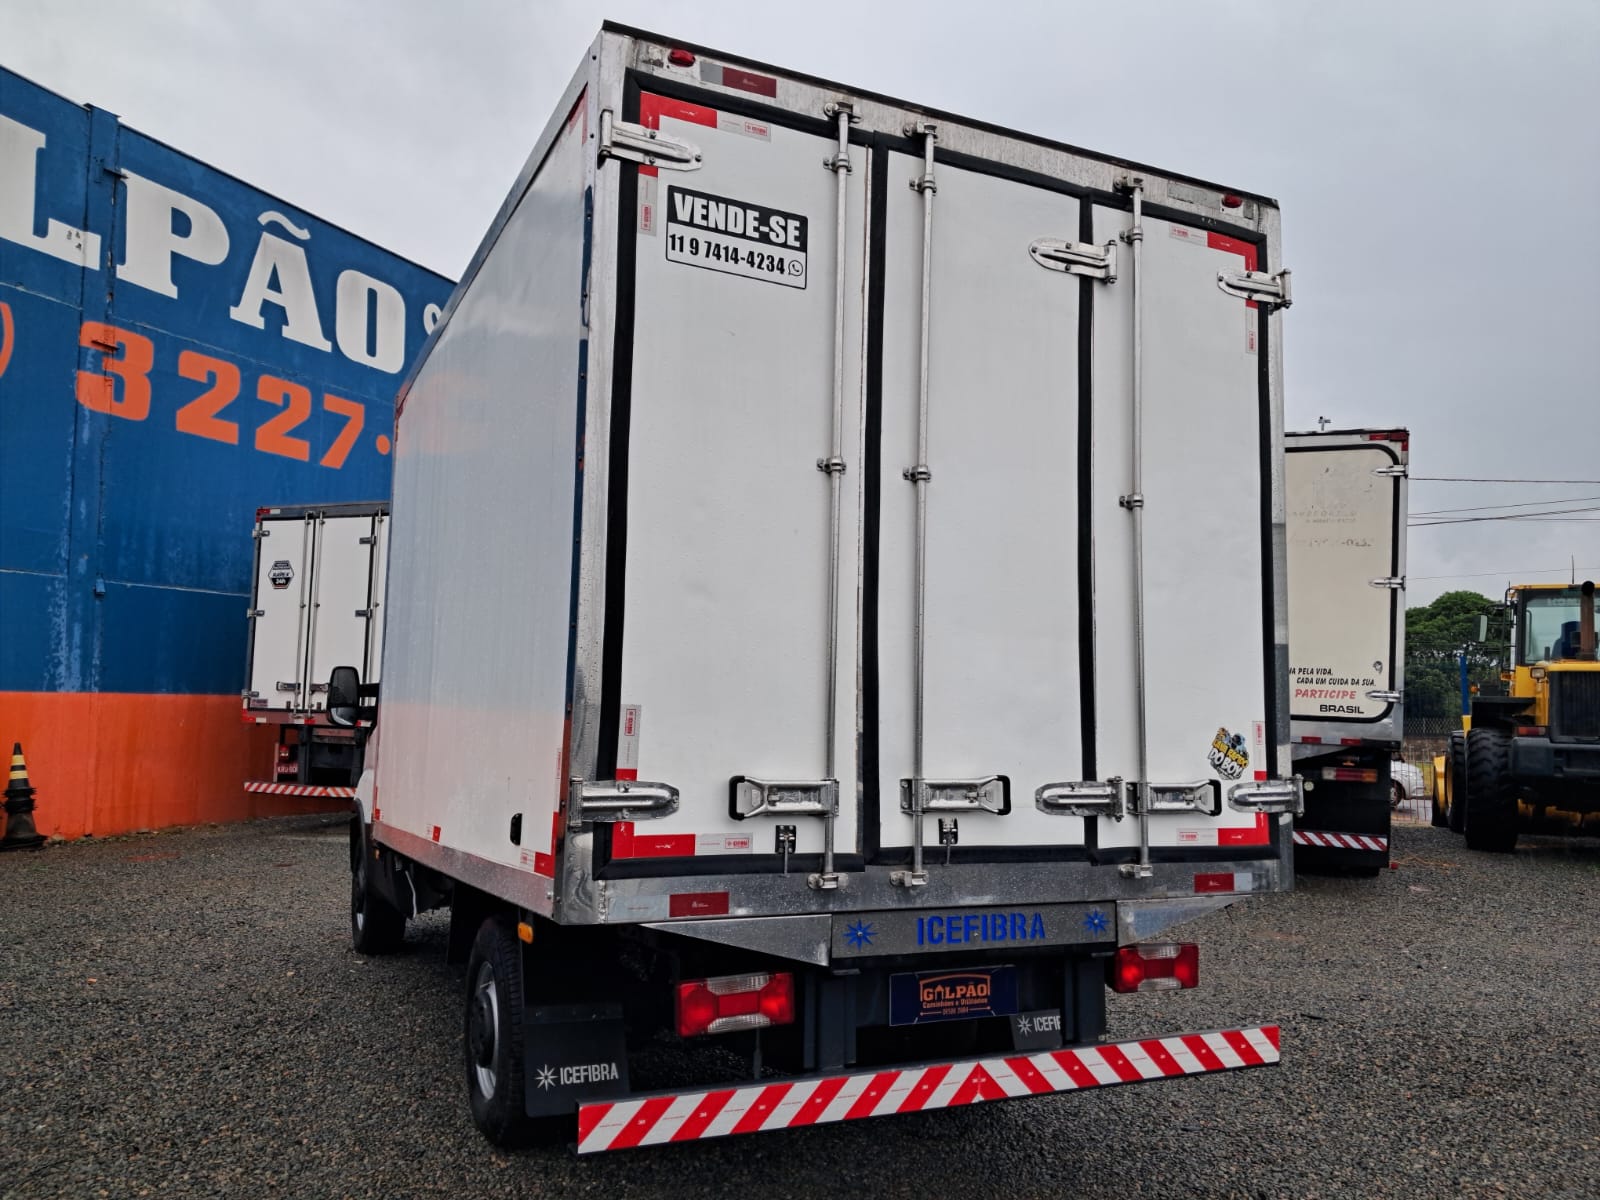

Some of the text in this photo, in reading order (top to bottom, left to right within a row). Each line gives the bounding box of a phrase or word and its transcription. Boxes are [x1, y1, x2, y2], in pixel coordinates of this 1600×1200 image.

[673, 192, 800, 248] VENDE-SE
[669, 234, 786, 275] 11 9 7414-4234
[1298, 667, 1314, 675] PELA
[1297, 677, 1314, 685] CADA
[1328, 678, 1349, 686] CUIDA
[1350, 678, 1360, 686] DA
[1295, 688, 1357, 700] PARTICIPE
[1320, 704, 1365, 714] BRASIL
[917, 912, 1046, 946] ICEFIBRA
[560, 1062, 619, 1085] ICEFIBRA
